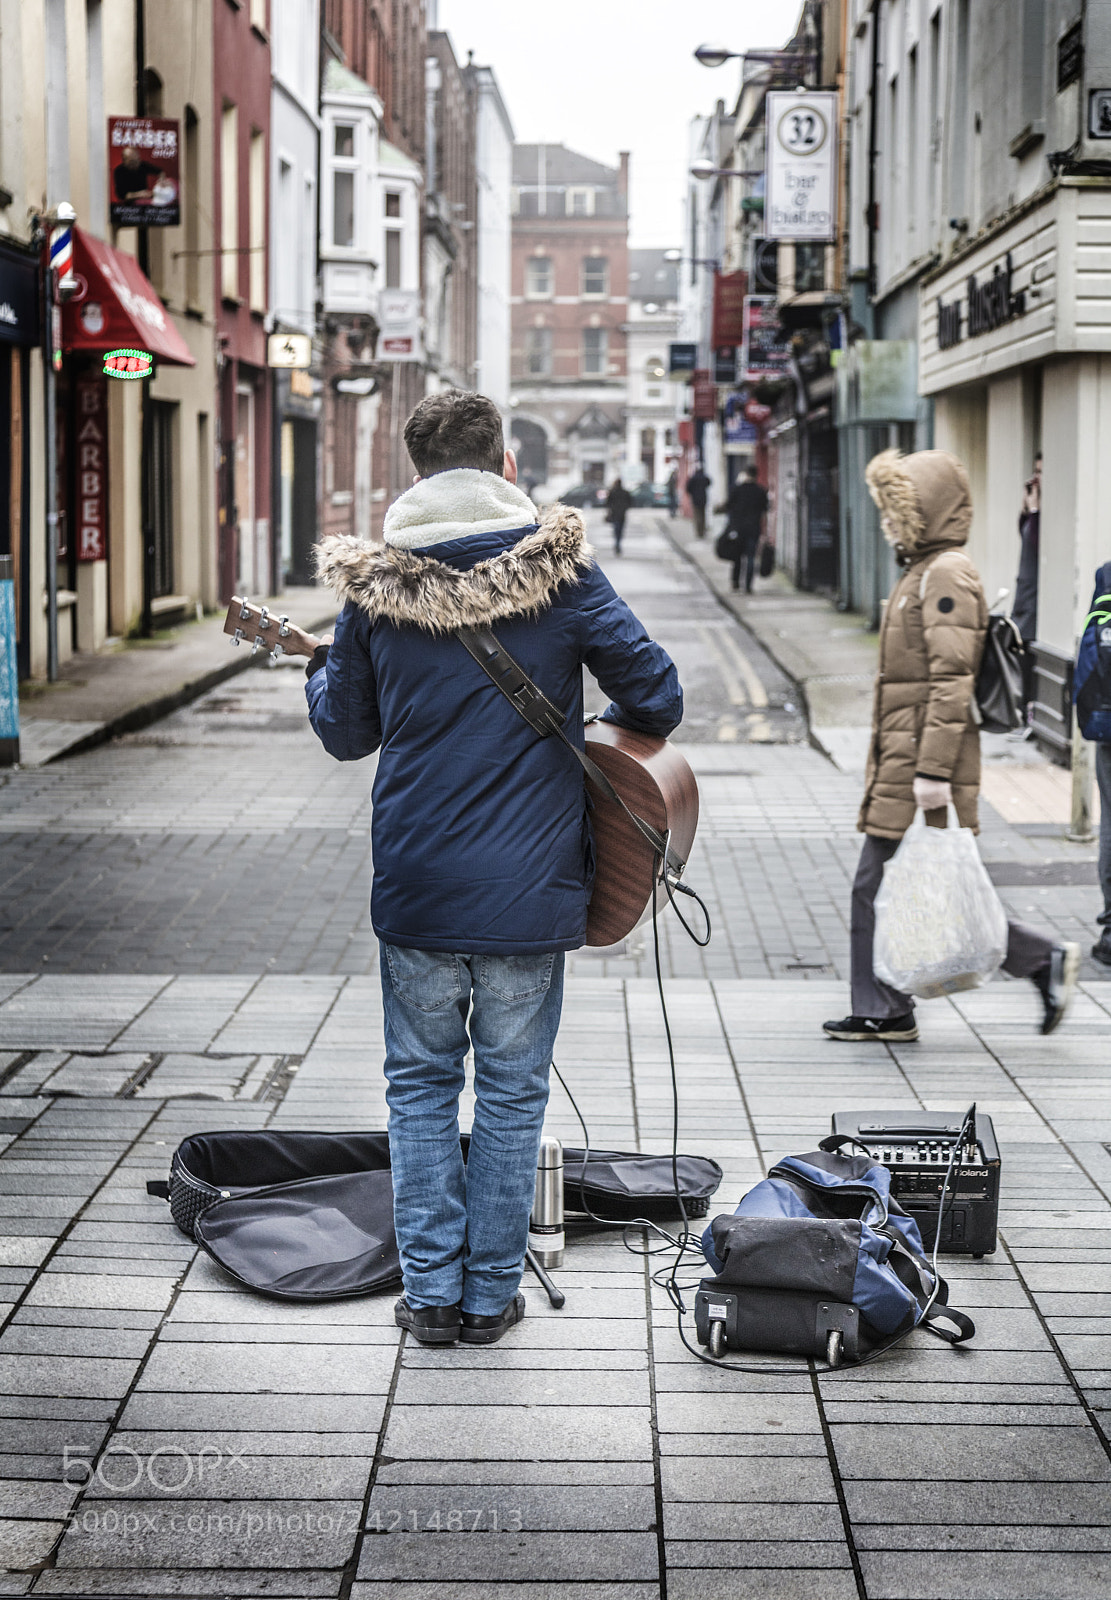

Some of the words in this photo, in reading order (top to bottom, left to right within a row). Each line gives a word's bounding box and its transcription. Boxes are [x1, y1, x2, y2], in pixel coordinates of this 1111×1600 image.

[111, 128, 177, 149] BARBER
[788, 114, 816, 145] 32
[784, 169, 818, 190] bar
[78, 389, 103, 551] BARBER
